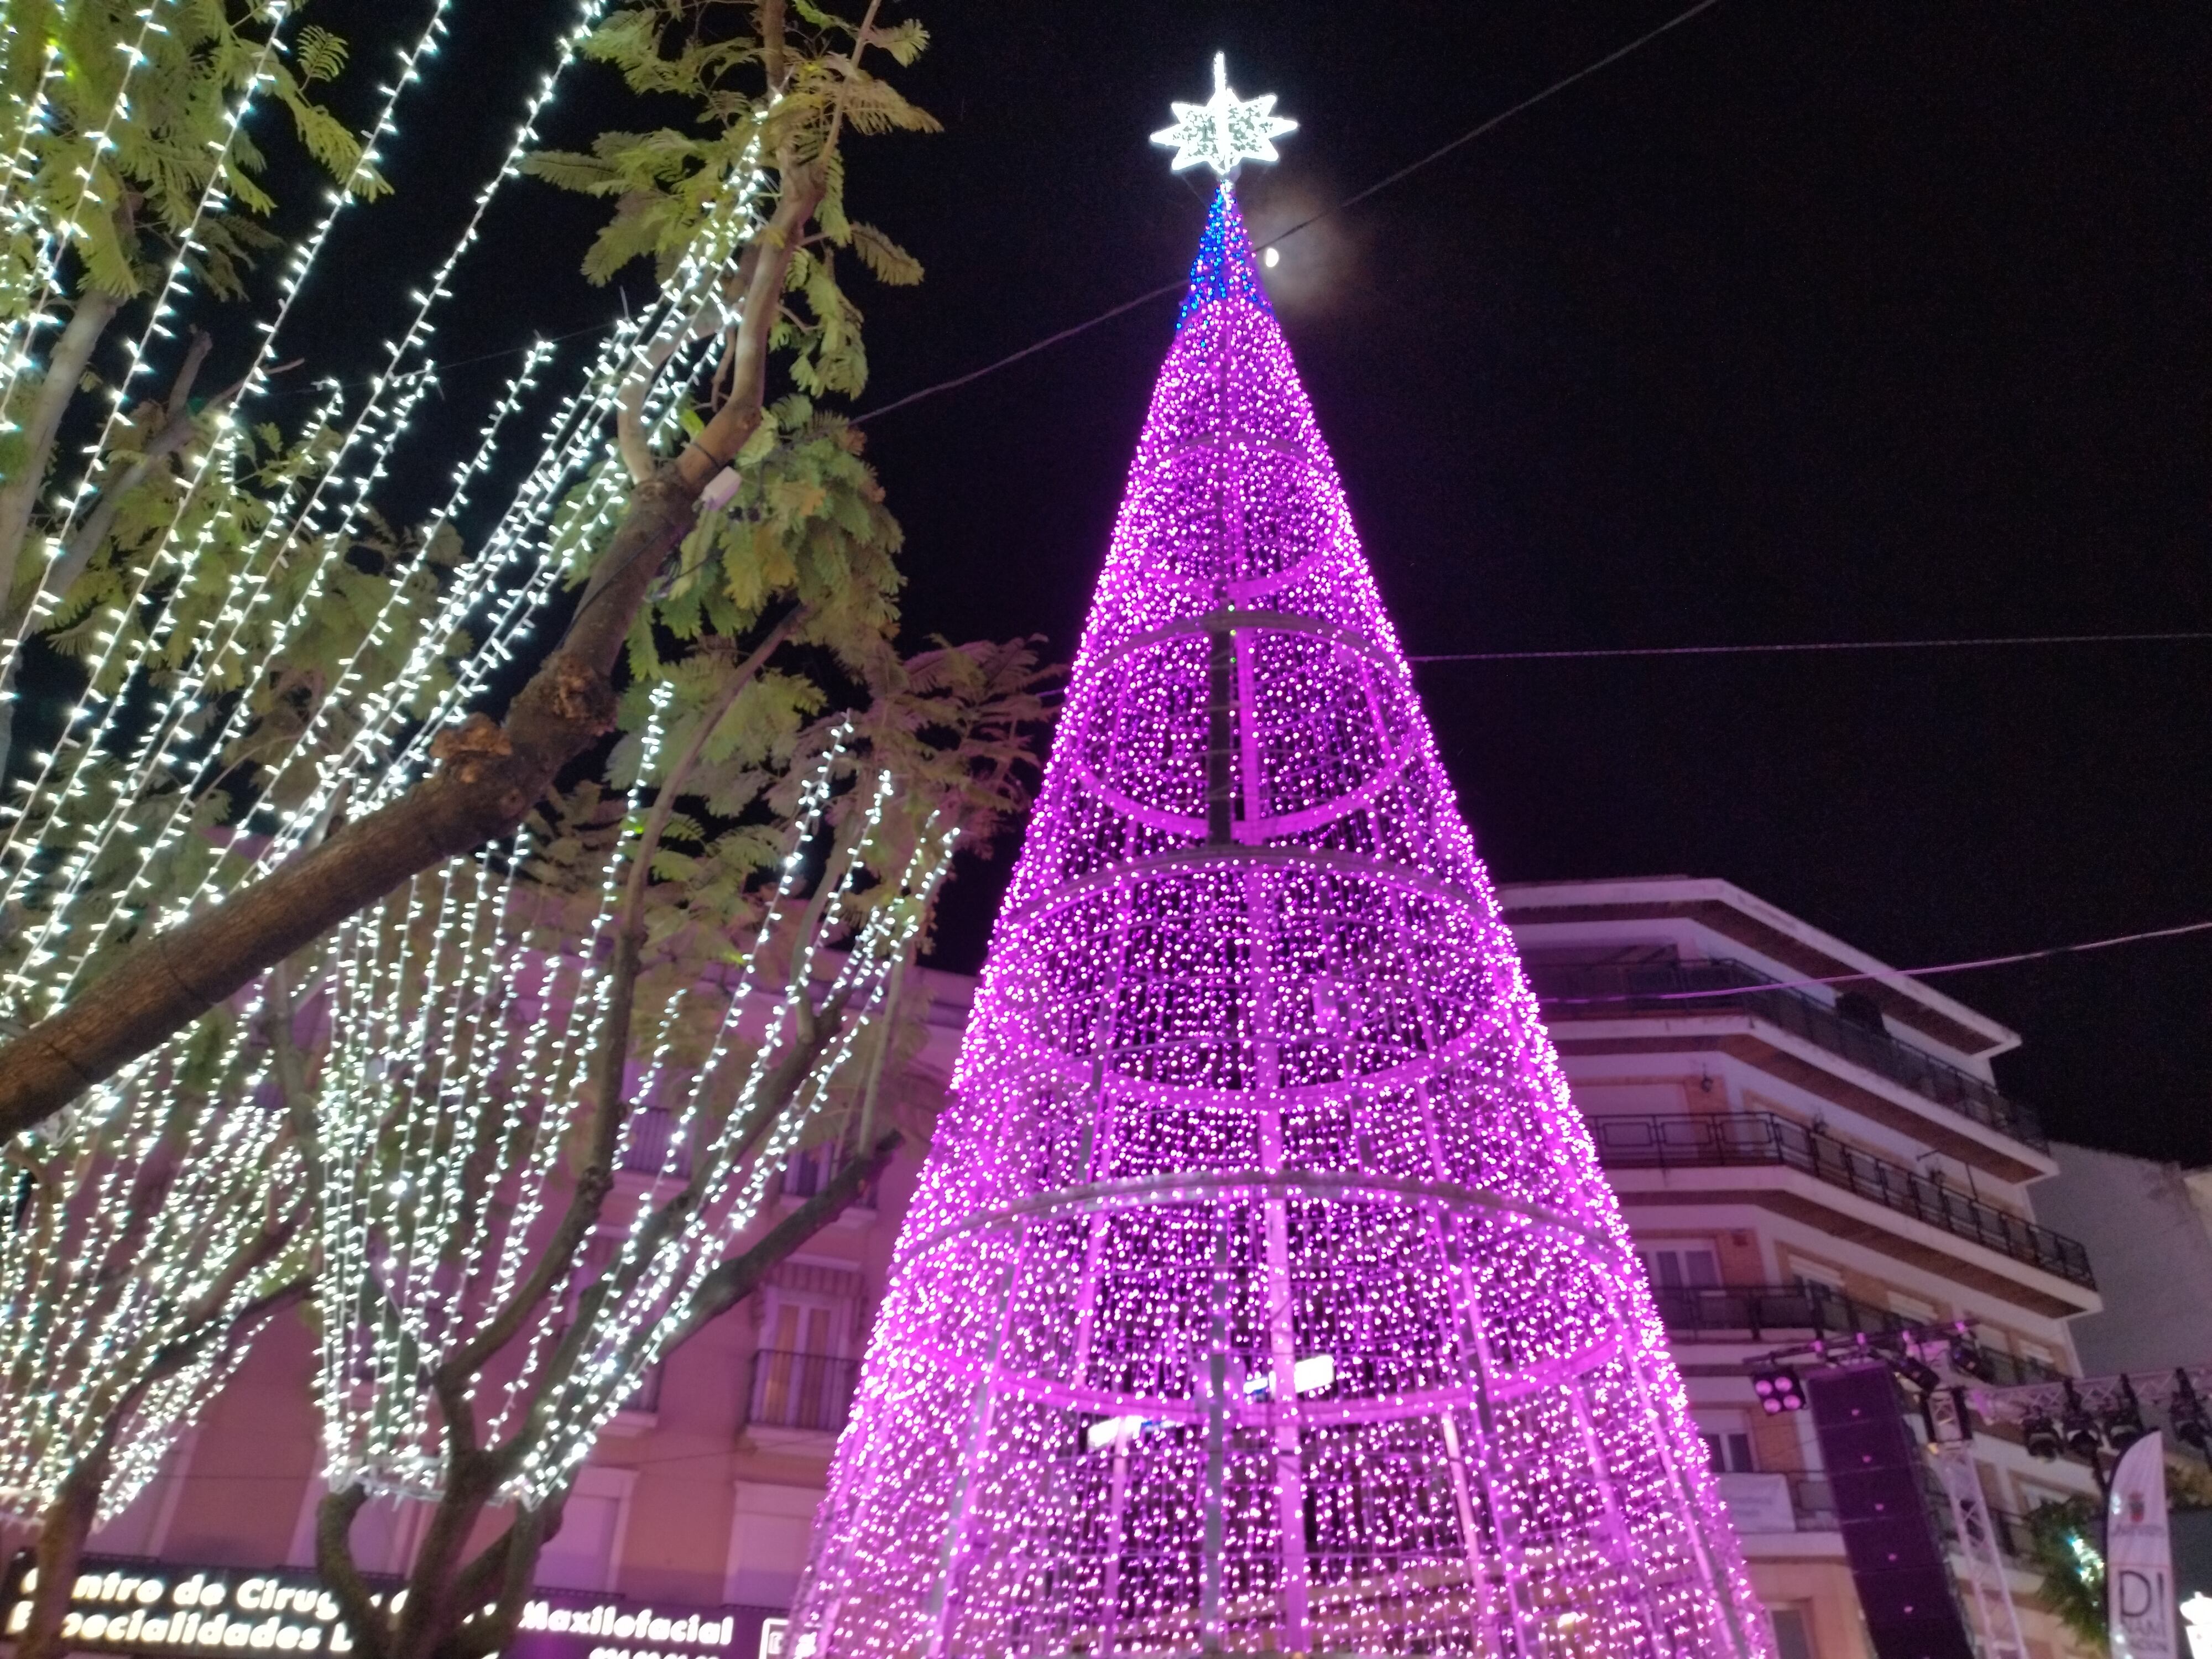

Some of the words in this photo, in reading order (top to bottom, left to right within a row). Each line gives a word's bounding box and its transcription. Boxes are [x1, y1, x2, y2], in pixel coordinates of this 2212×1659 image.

[20, 1567, 164, 1603] ntro
[173, 1574, 226, 1605] de
[237, 1578, 382, 1620] Cirug
[6, 1600, 323, 1651] Epecialidades
[519, 1600, 733, 1646] Maxilofacial
